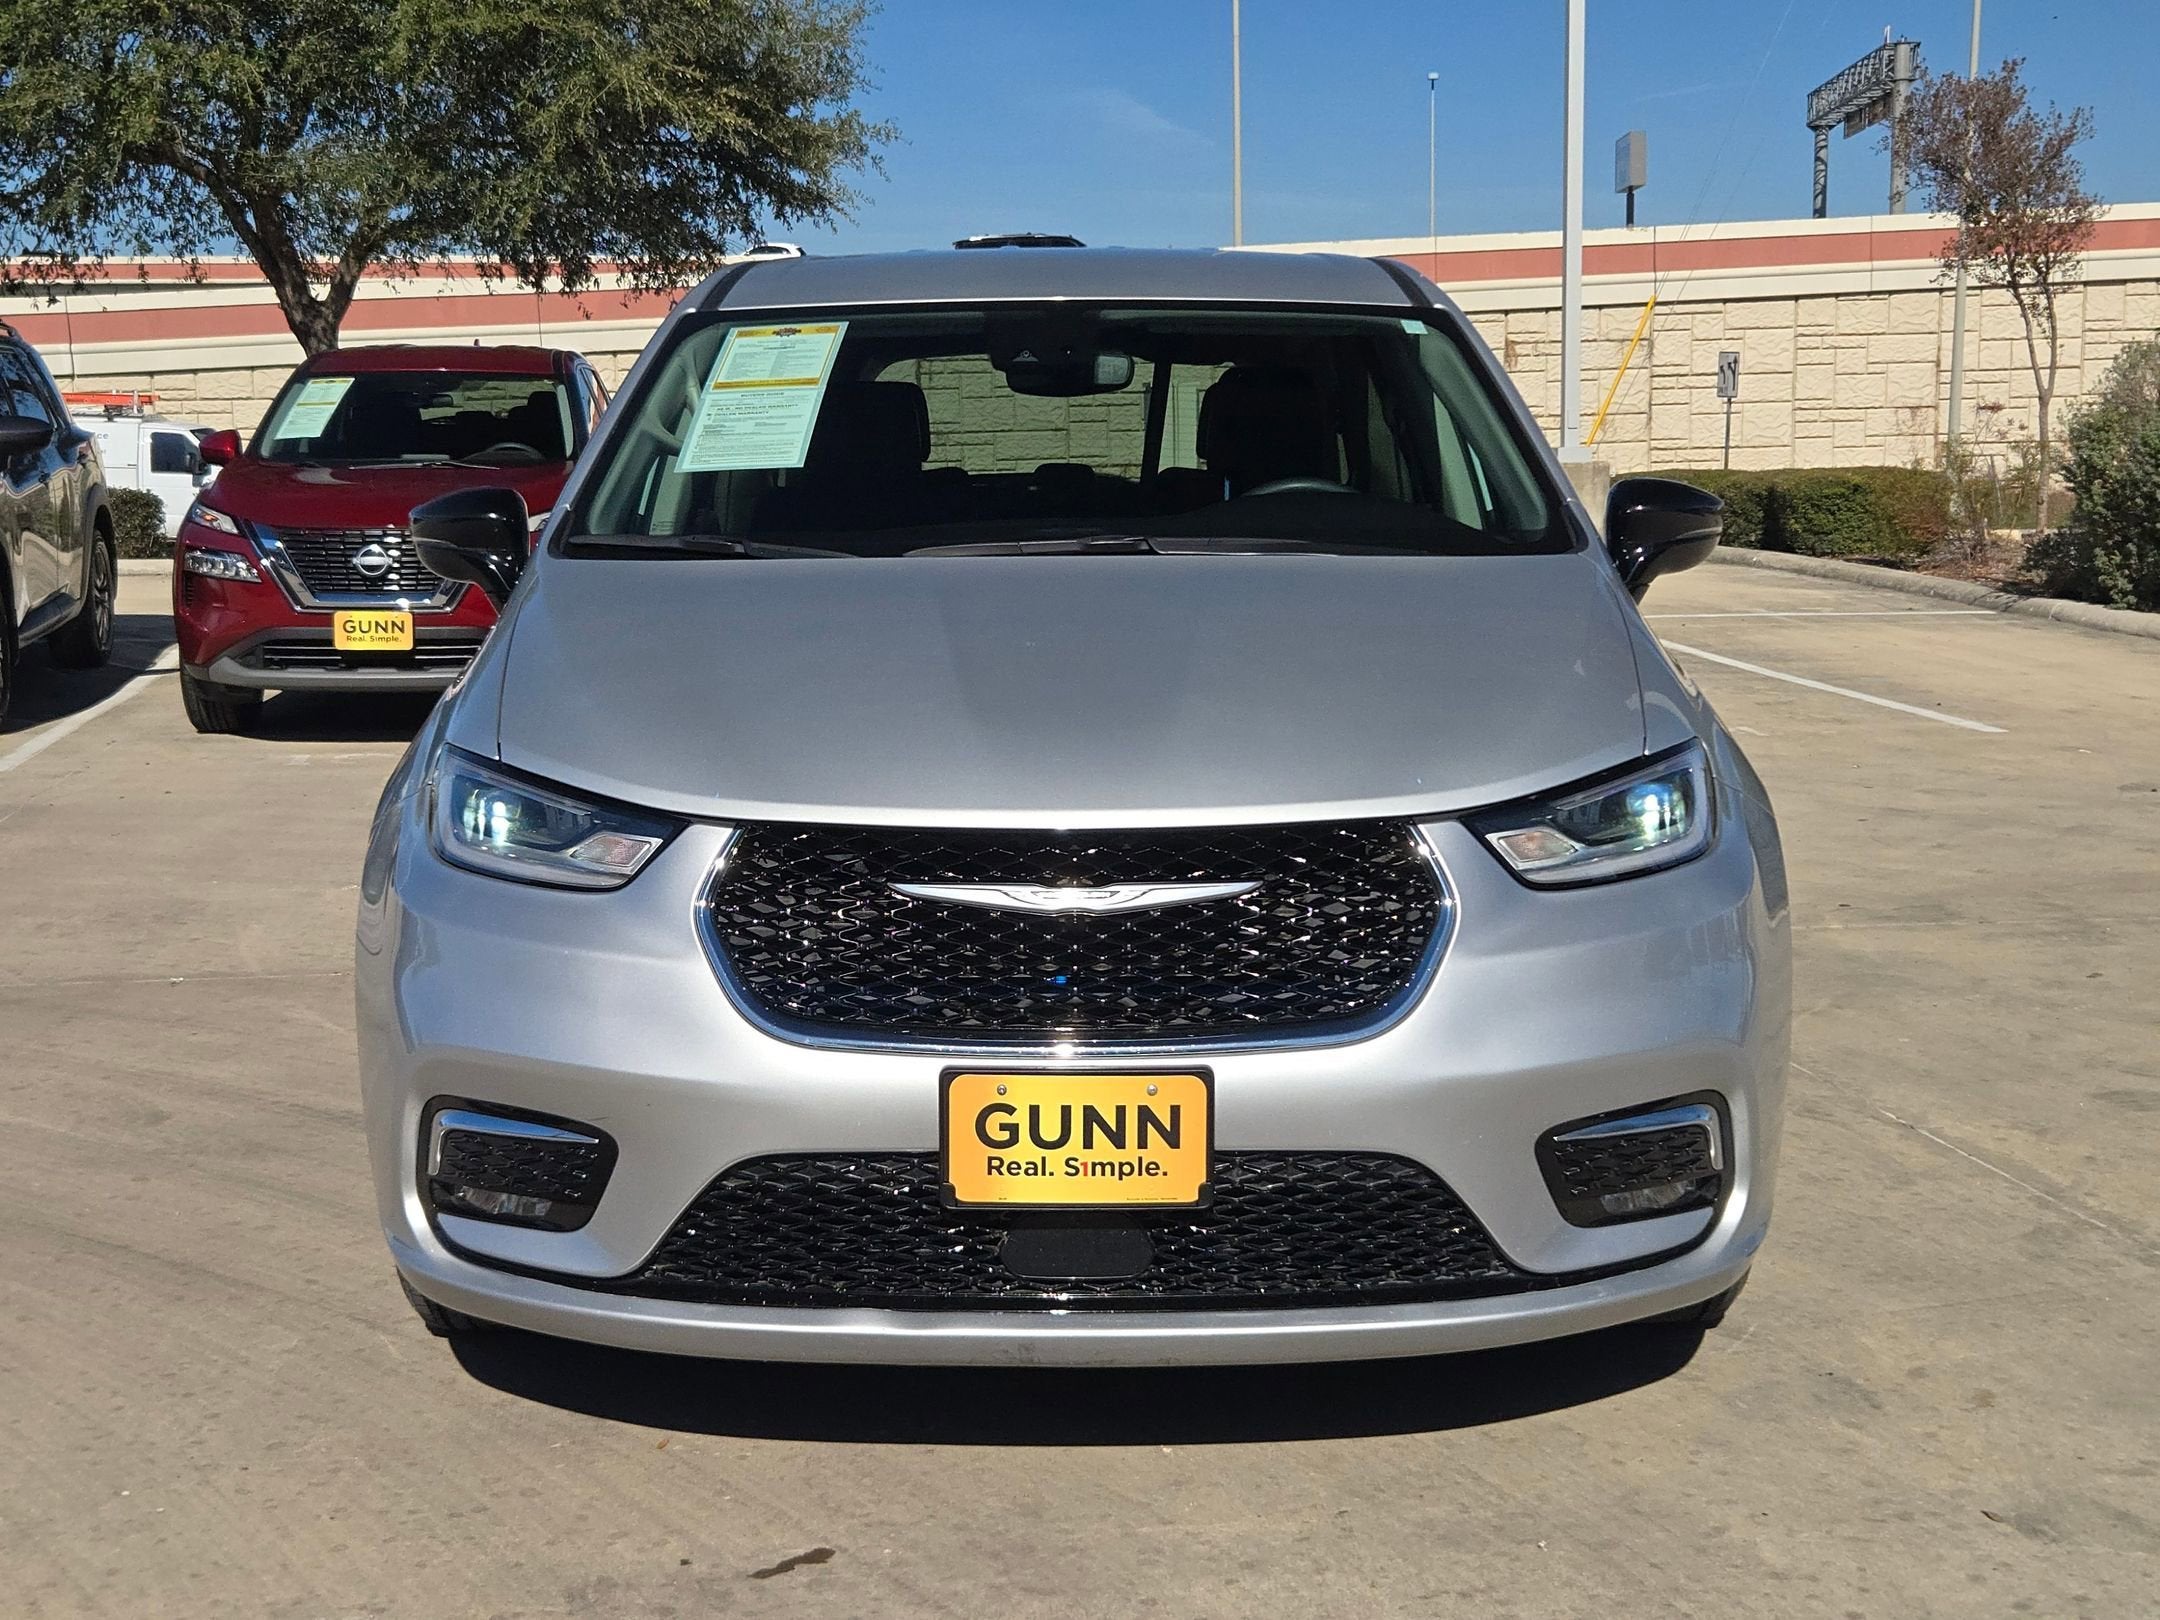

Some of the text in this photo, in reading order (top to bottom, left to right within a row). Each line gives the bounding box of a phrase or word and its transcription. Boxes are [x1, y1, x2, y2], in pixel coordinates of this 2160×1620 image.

[342, 619, 405, 634] GUNN
[974, 1102, 1181, 1150] GUNN
[987, 1156, 1055, 1177] Real.
